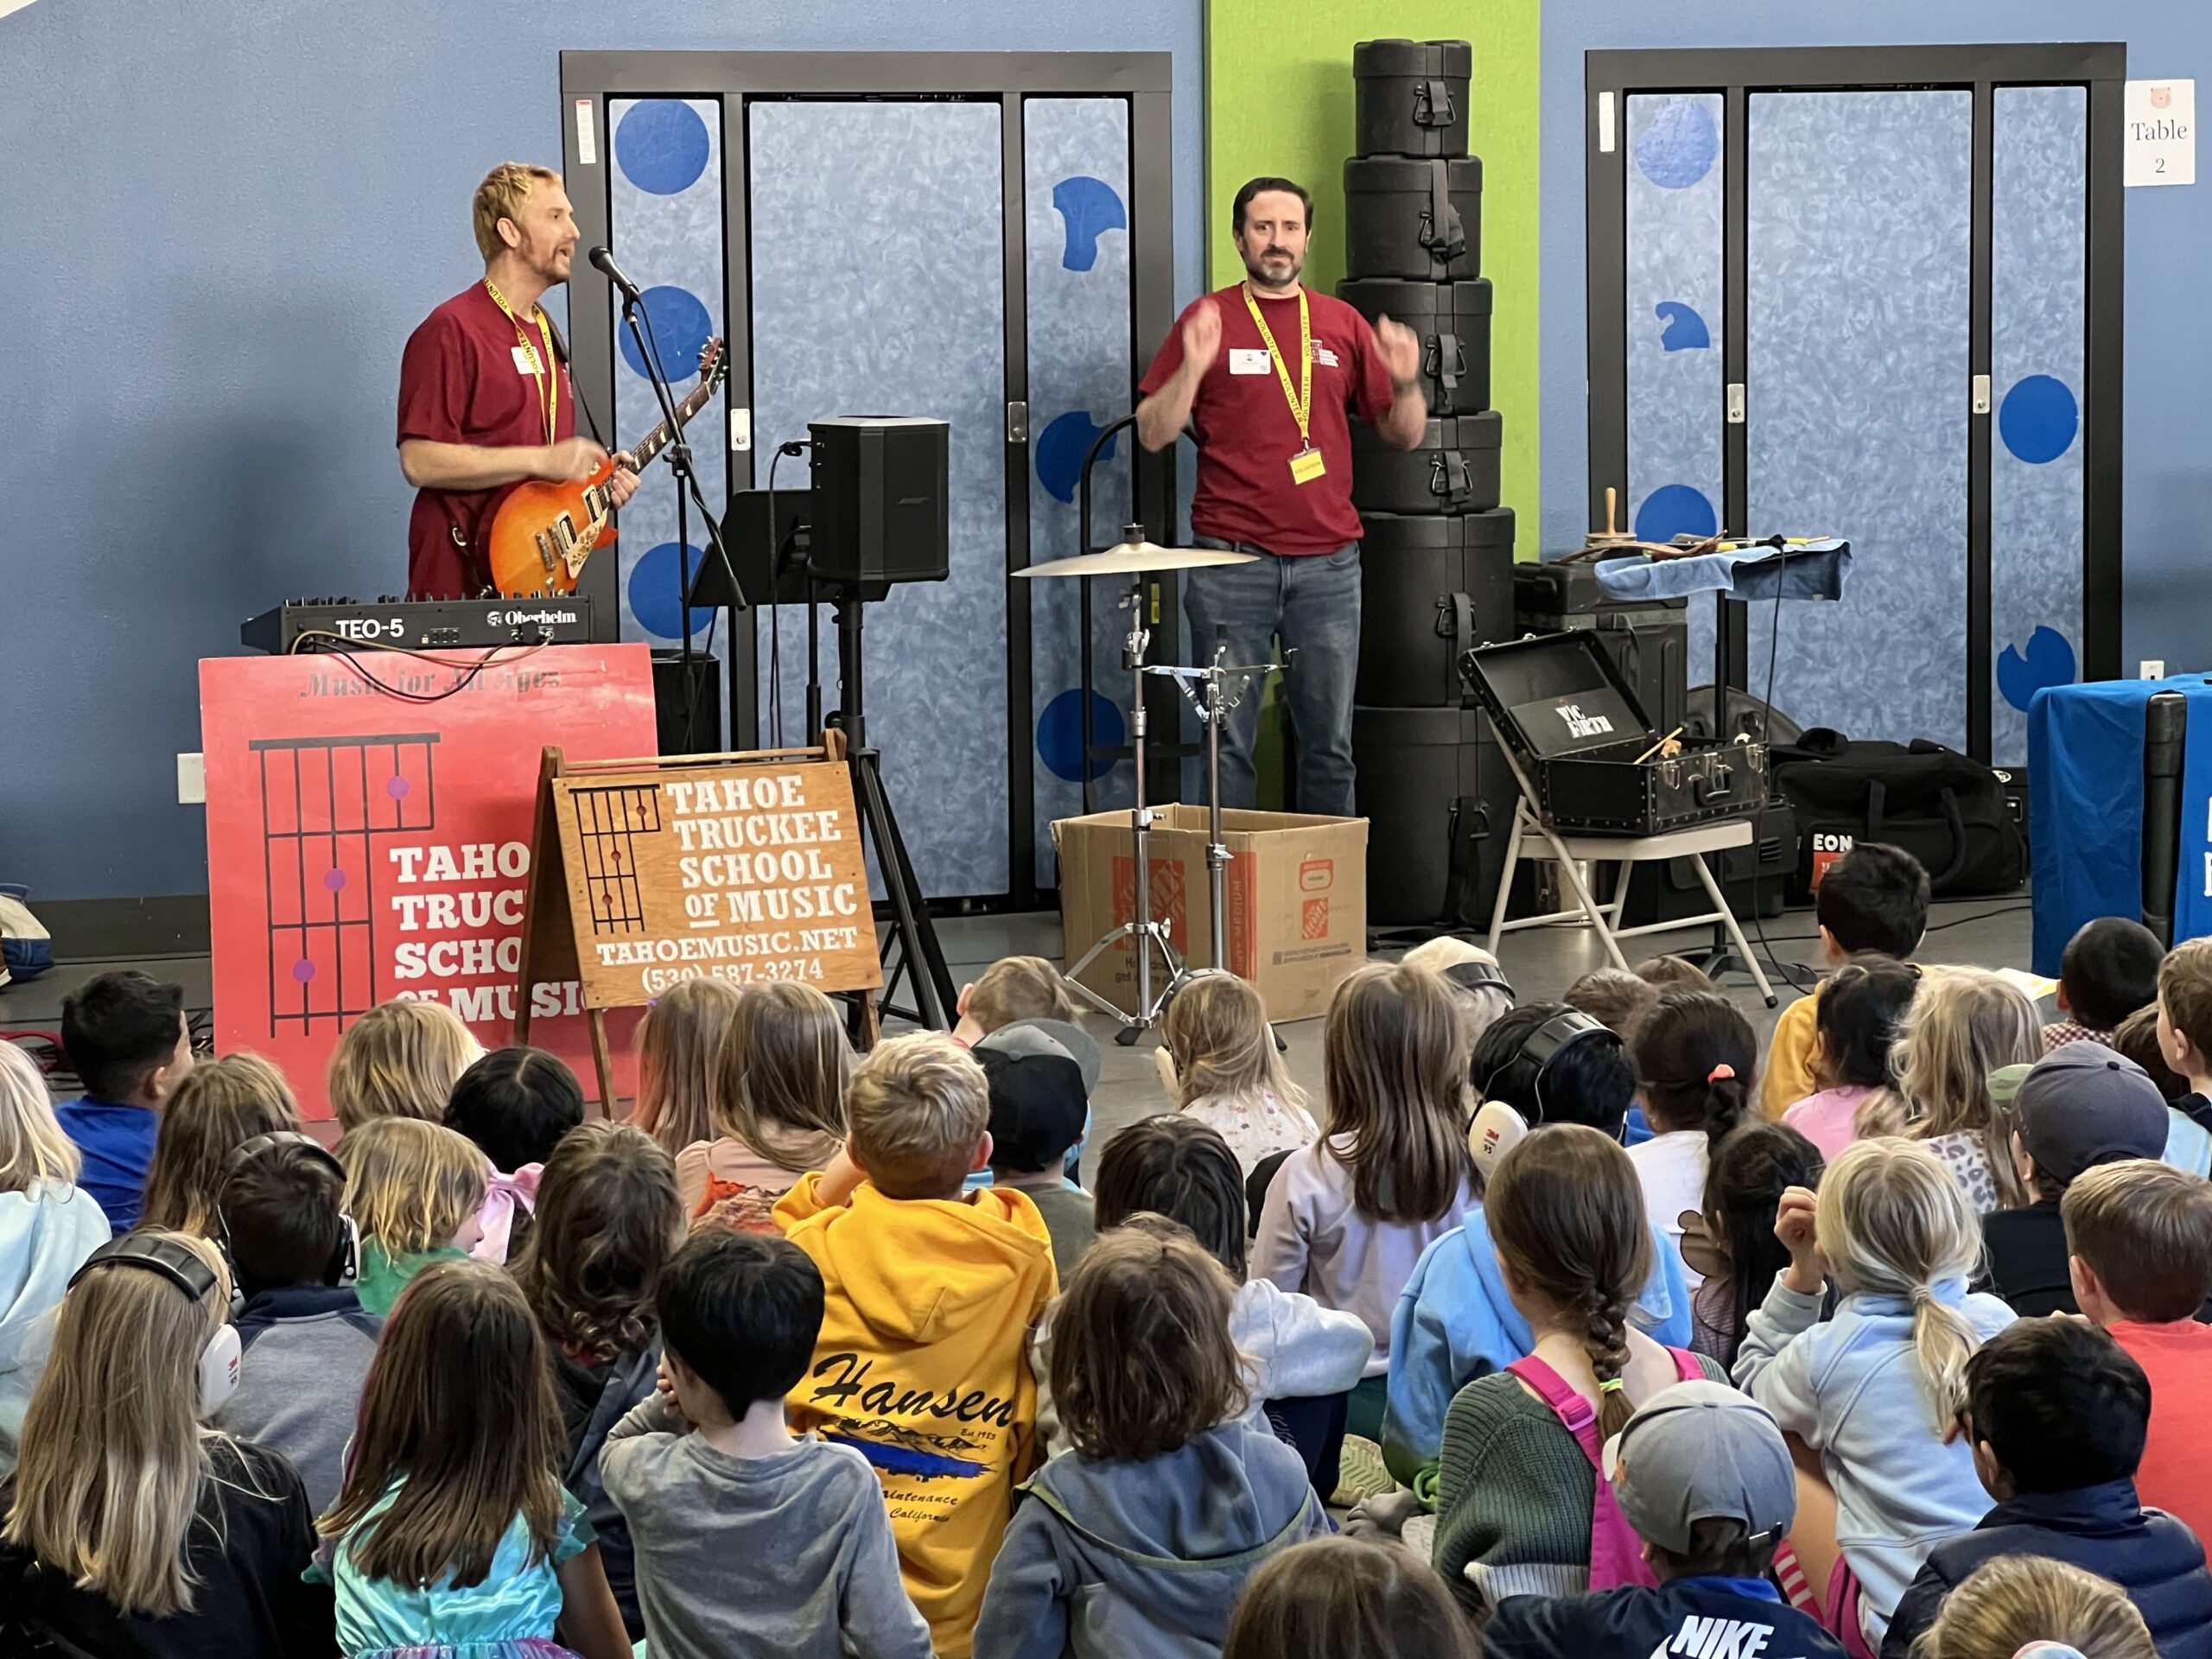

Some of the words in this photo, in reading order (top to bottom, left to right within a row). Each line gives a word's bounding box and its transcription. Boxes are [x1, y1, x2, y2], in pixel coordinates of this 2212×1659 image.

[2131, 119, 2188, 141] Table
[2155, 157, 2166, 174] 2
[1257, 318, 1280, 359] VOLUNTEER
[1283, 377, 1303, 423] VOLUNTEER
[335, 618, 404, 639] TEO-5
[505, 610, 577, 626] Oberheim
[397, 668, 435, 694] for
[1554, 704, 1586, 722] VIC
[1567, 715, 1614, 739] FIRTH
[665, 775, 805, 815] TAHOE
[671, 810, 842, 851] TRUCKEE
[1813, 833, 1853, 852] EON
[390, 841, 531, 883] TAHO
[679, 849, 833, 889] SCHOOL
[391, 889, 527, 931] TRUC
[684, 893, 719, 918] OF
[726, 883, 858, 924] MUSIC
[1232, 880, 1243, 938] MEDIUM
[394, 937, 523, 979] SCHO
[596, 926, 858, 966] TAHOEMUSIC.NET
[641, 963, 704, 994] (530)
[711, 957, 823, 986] 587-3274
[448, 981, 588, 1021] MUSI
[1484, 1143, 1493, 1154] 95
[1486, 1128, 1500, 1141] 3M
[809, 1352, 1014, 1427] Hansen
[882, 1490, 959, 1506] aintenance
[1669, 1614, 1775, 1659] NIKE
